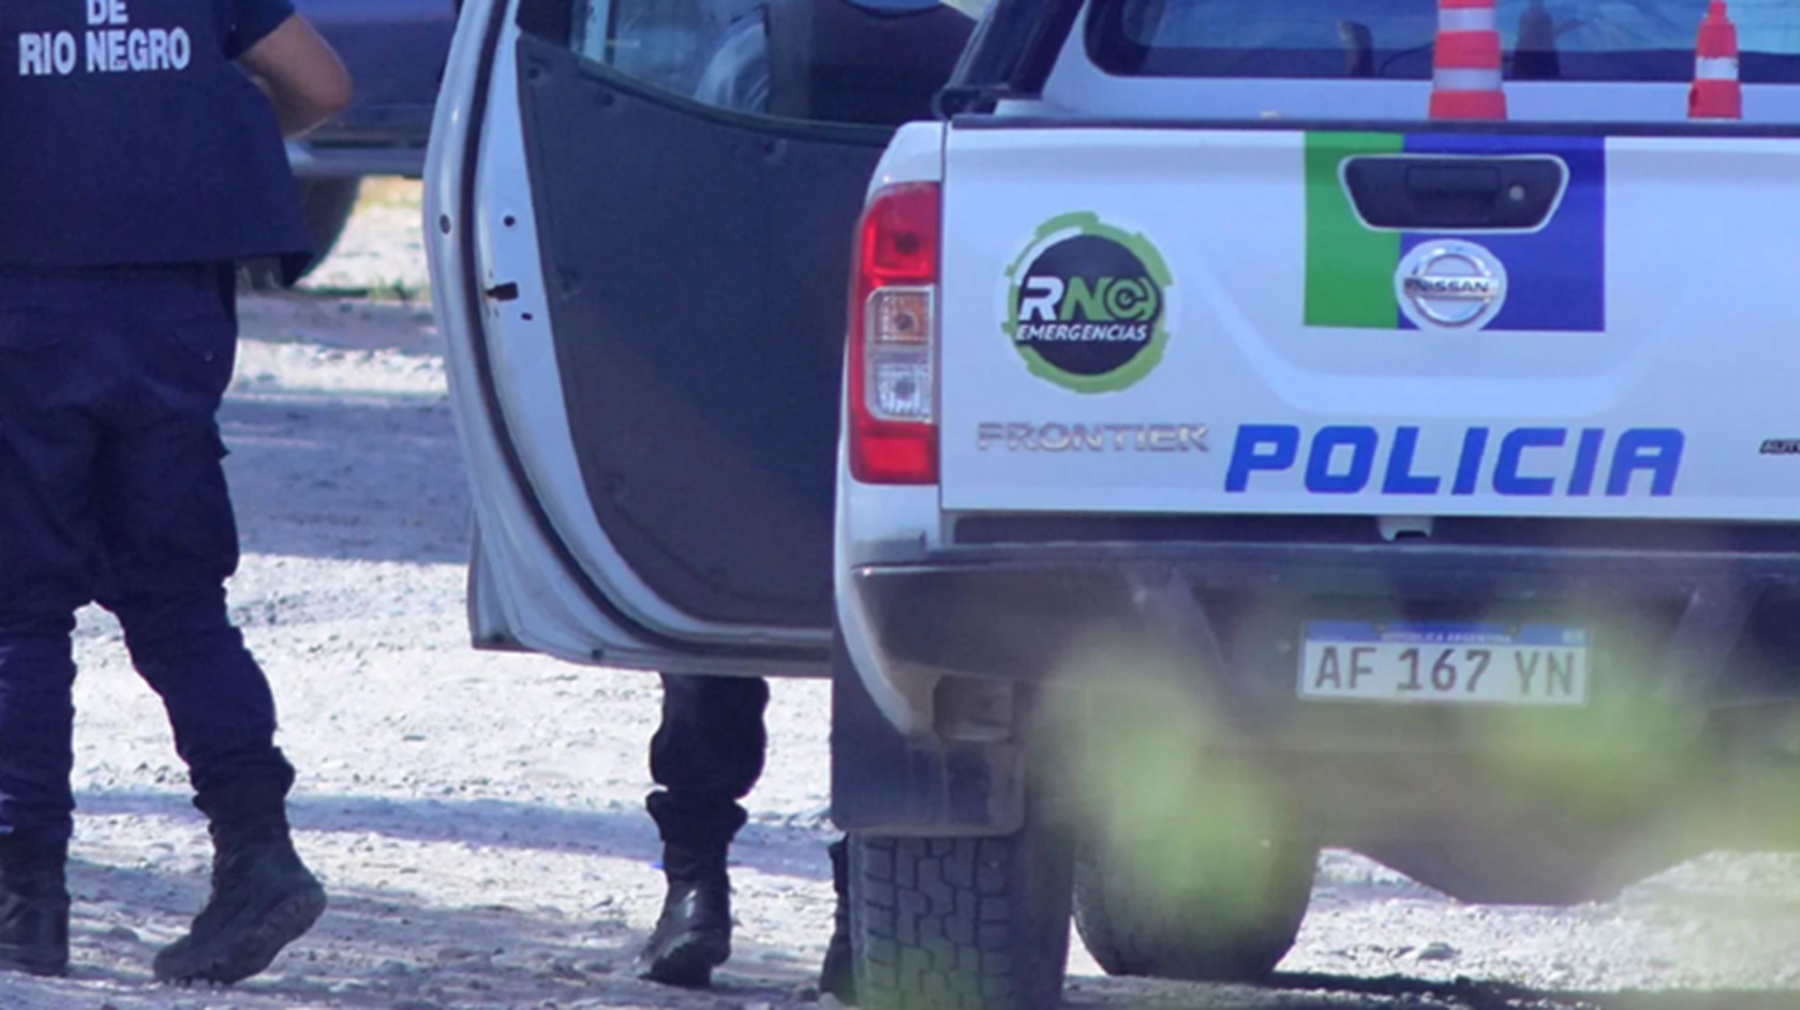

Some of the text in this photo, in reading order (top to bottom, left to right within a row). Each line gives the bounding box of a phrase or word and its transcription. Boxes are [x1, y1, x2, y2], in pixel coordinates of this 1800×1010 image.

[87, 0, 128, 25] DE
[19, 26, 191, 75] RIO NEGRO
[1414, 280, 1490, 293] NISSAN
[1016, 323, 1149, 341] EMERGENCIAS
[977, 422, 1210, 452] FRONTIER
[1224, 424, 1686, 497] POLICIA
[1314, 646, 1575, 696] AF 167 YN
